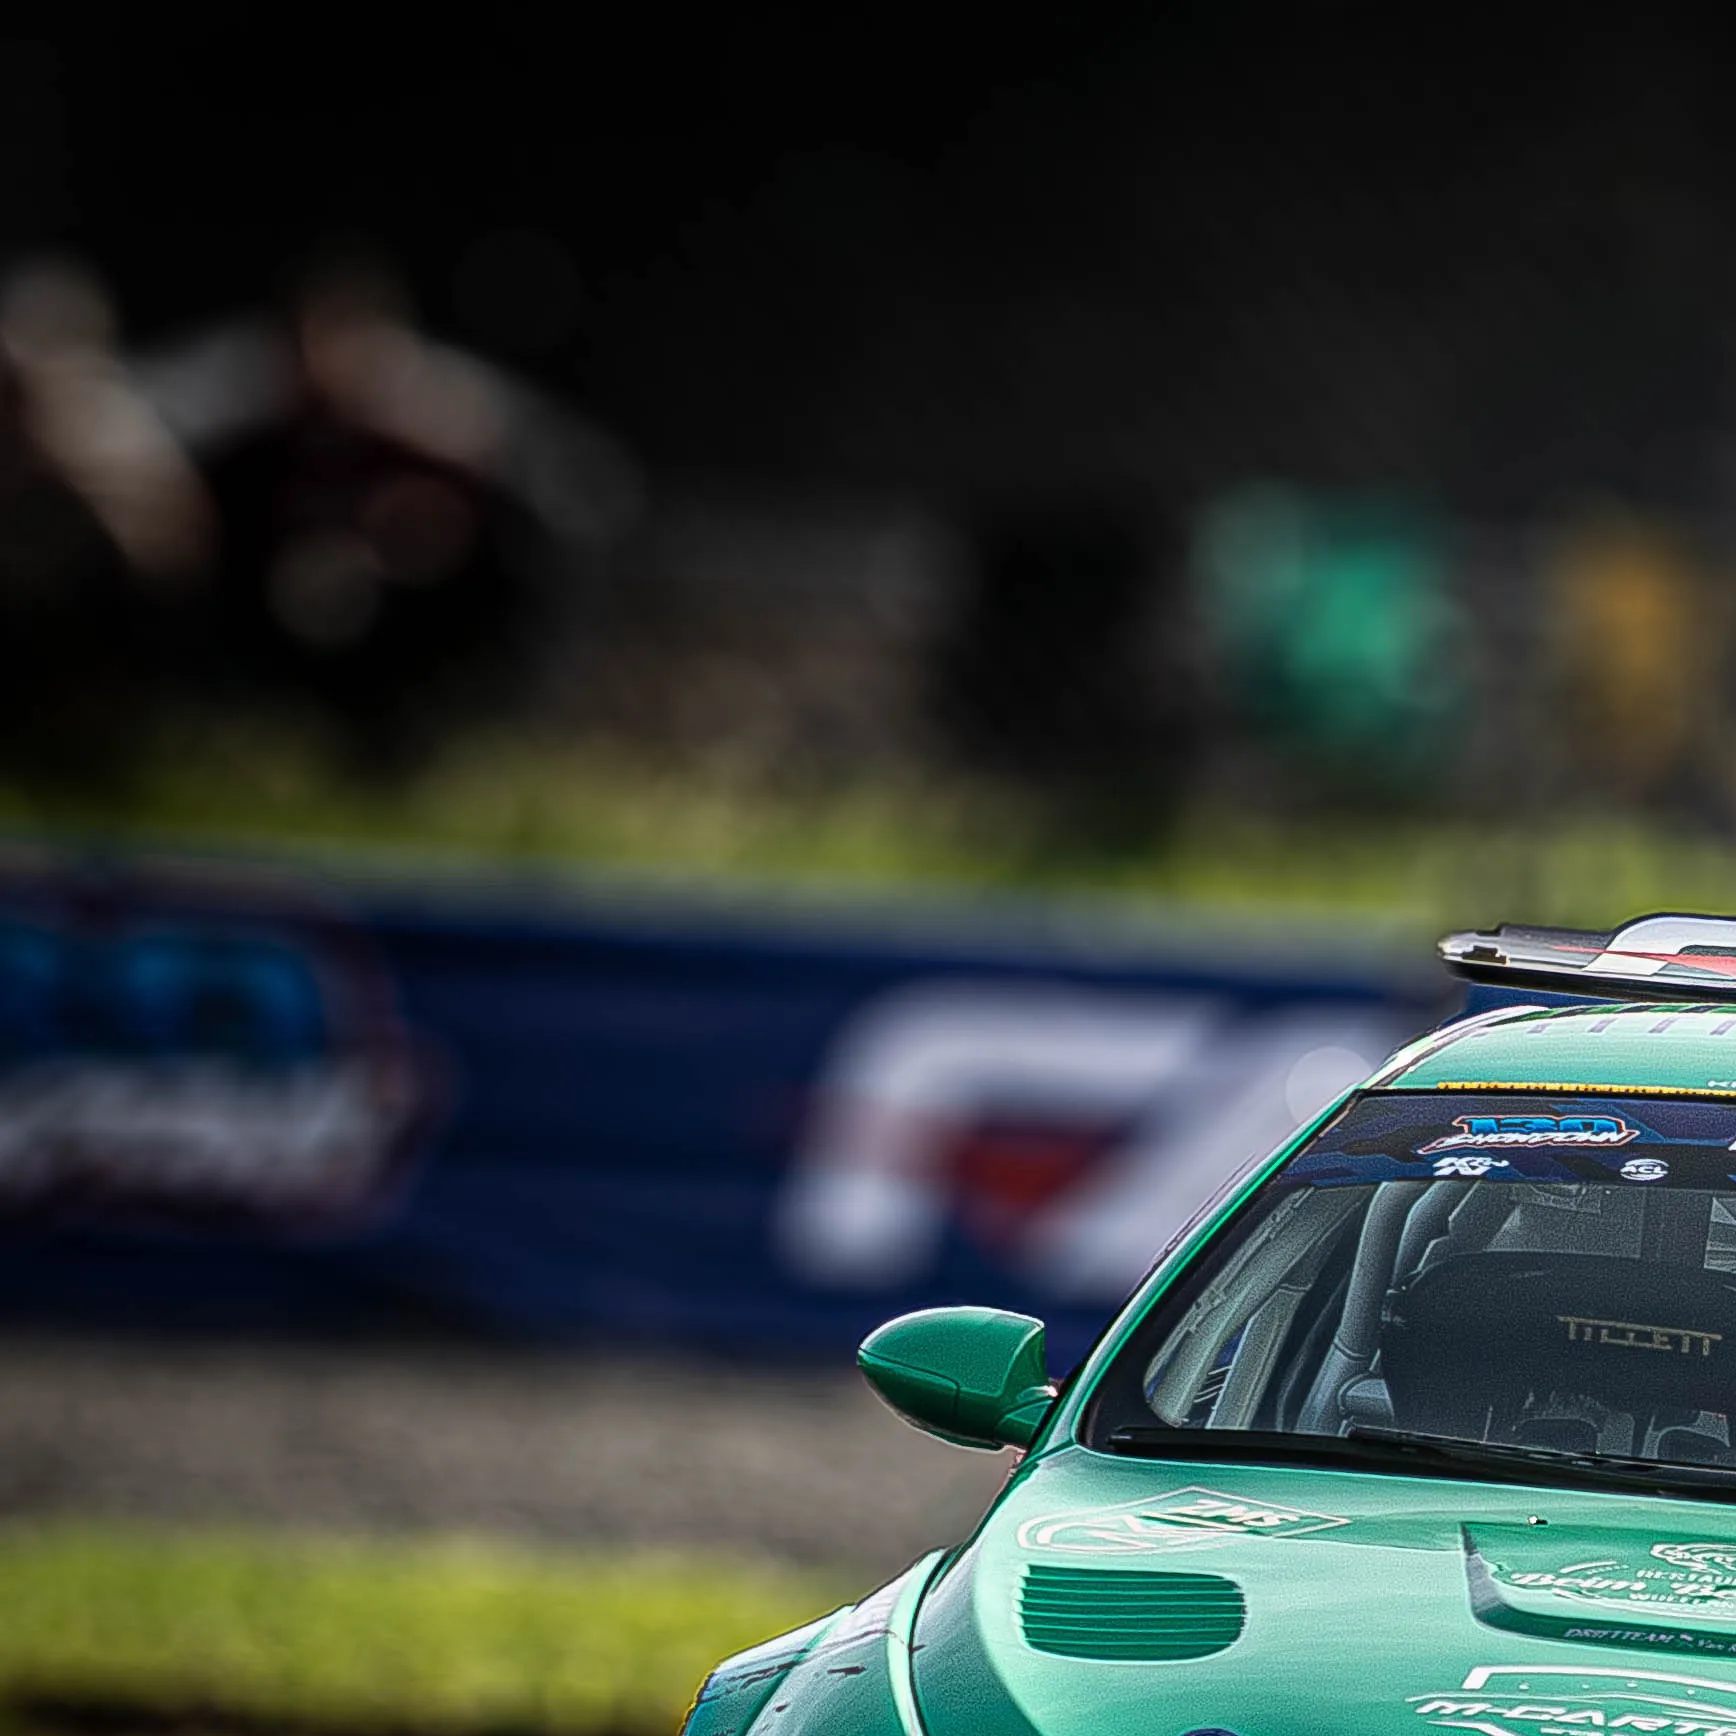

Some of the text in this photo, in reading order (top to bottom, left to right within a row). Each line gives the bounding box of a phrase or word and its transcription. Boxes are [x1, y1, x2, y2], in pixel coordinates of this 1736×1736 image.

[1437, 1132, 1628, 1149] SHOWDOWN
[1619, 1163, 1669, 1176] ACL
[1556, 1315, 1723, 1356] TILLETT
